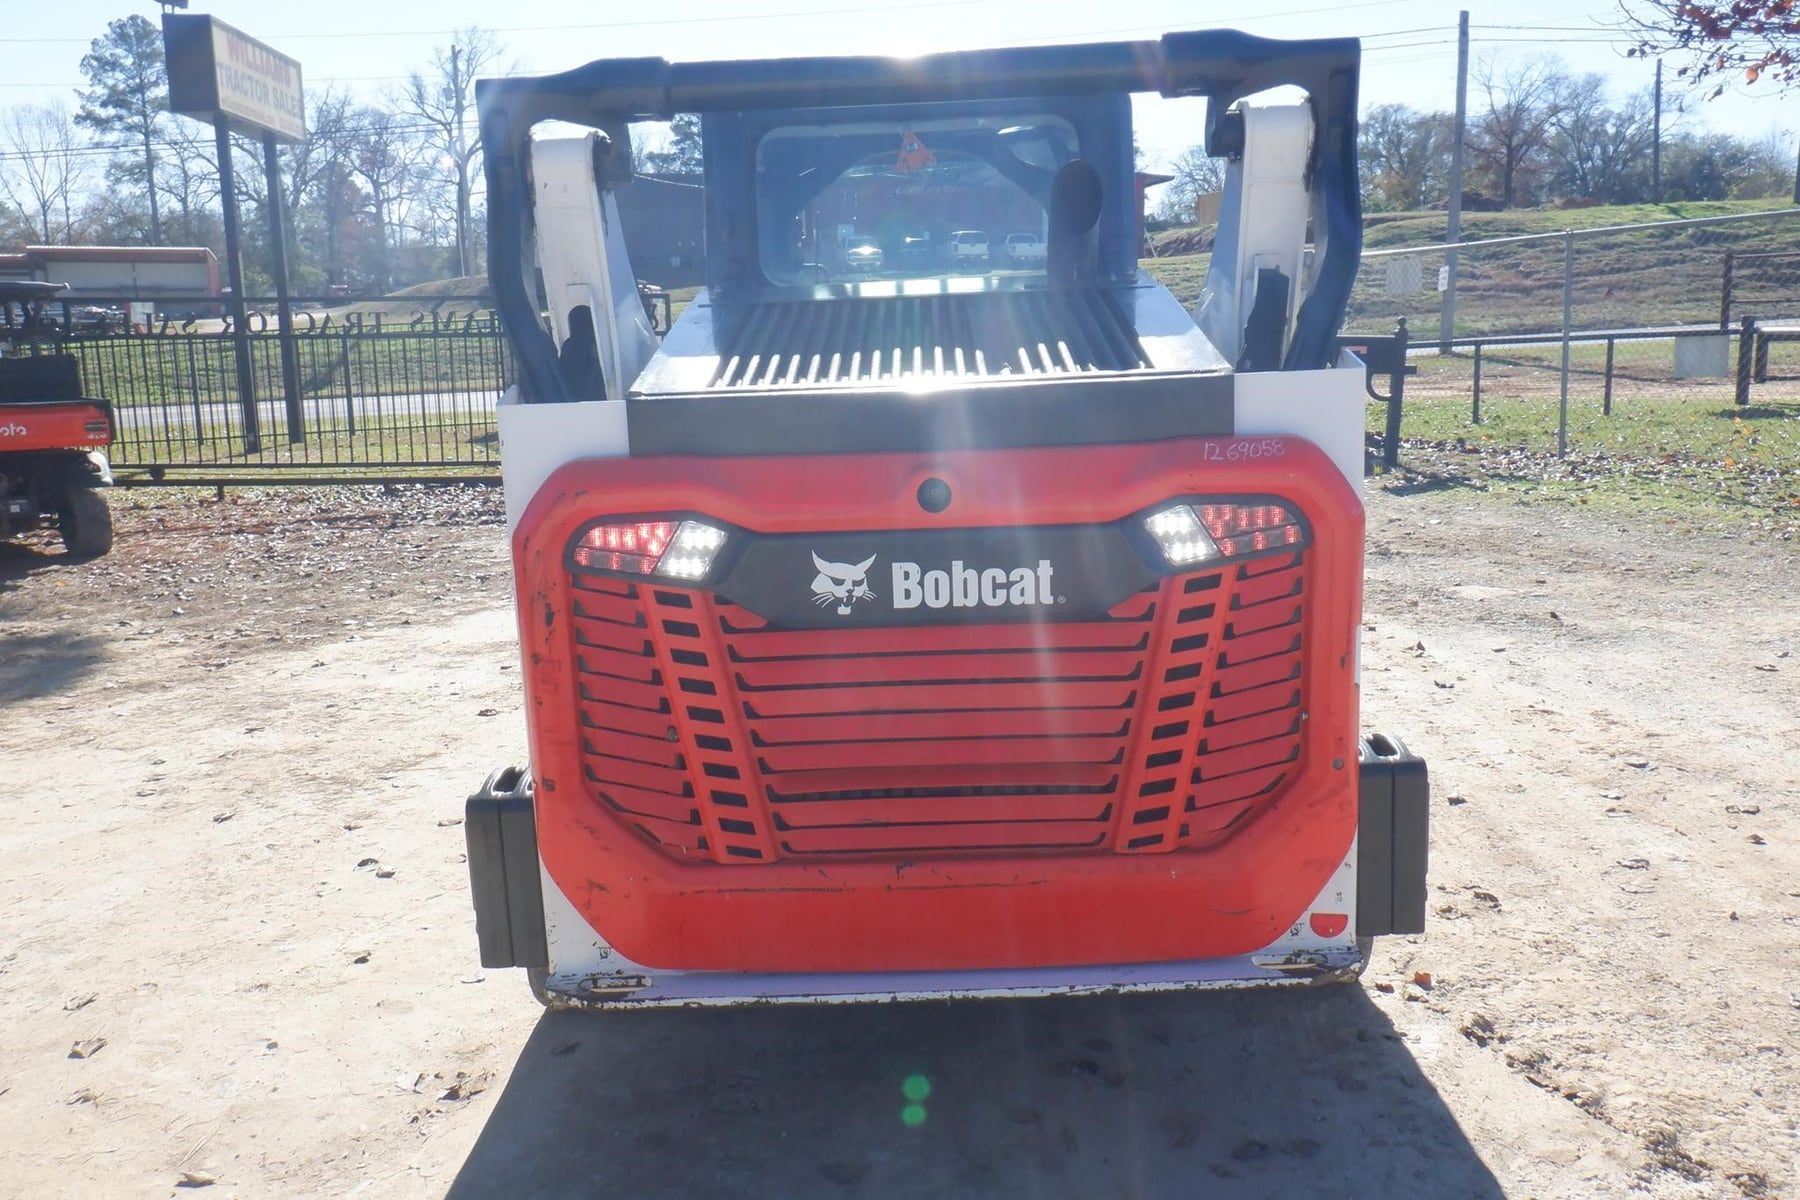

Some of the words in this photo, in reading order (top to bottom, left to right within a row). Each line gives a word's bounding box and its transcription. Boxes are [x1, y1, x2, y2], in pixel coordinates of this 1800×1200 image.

[216, 62, 271, 106] TRACTOR
[272, 87, 303, 119] SALES
[892, 559, 1054, 609] Bobcat
